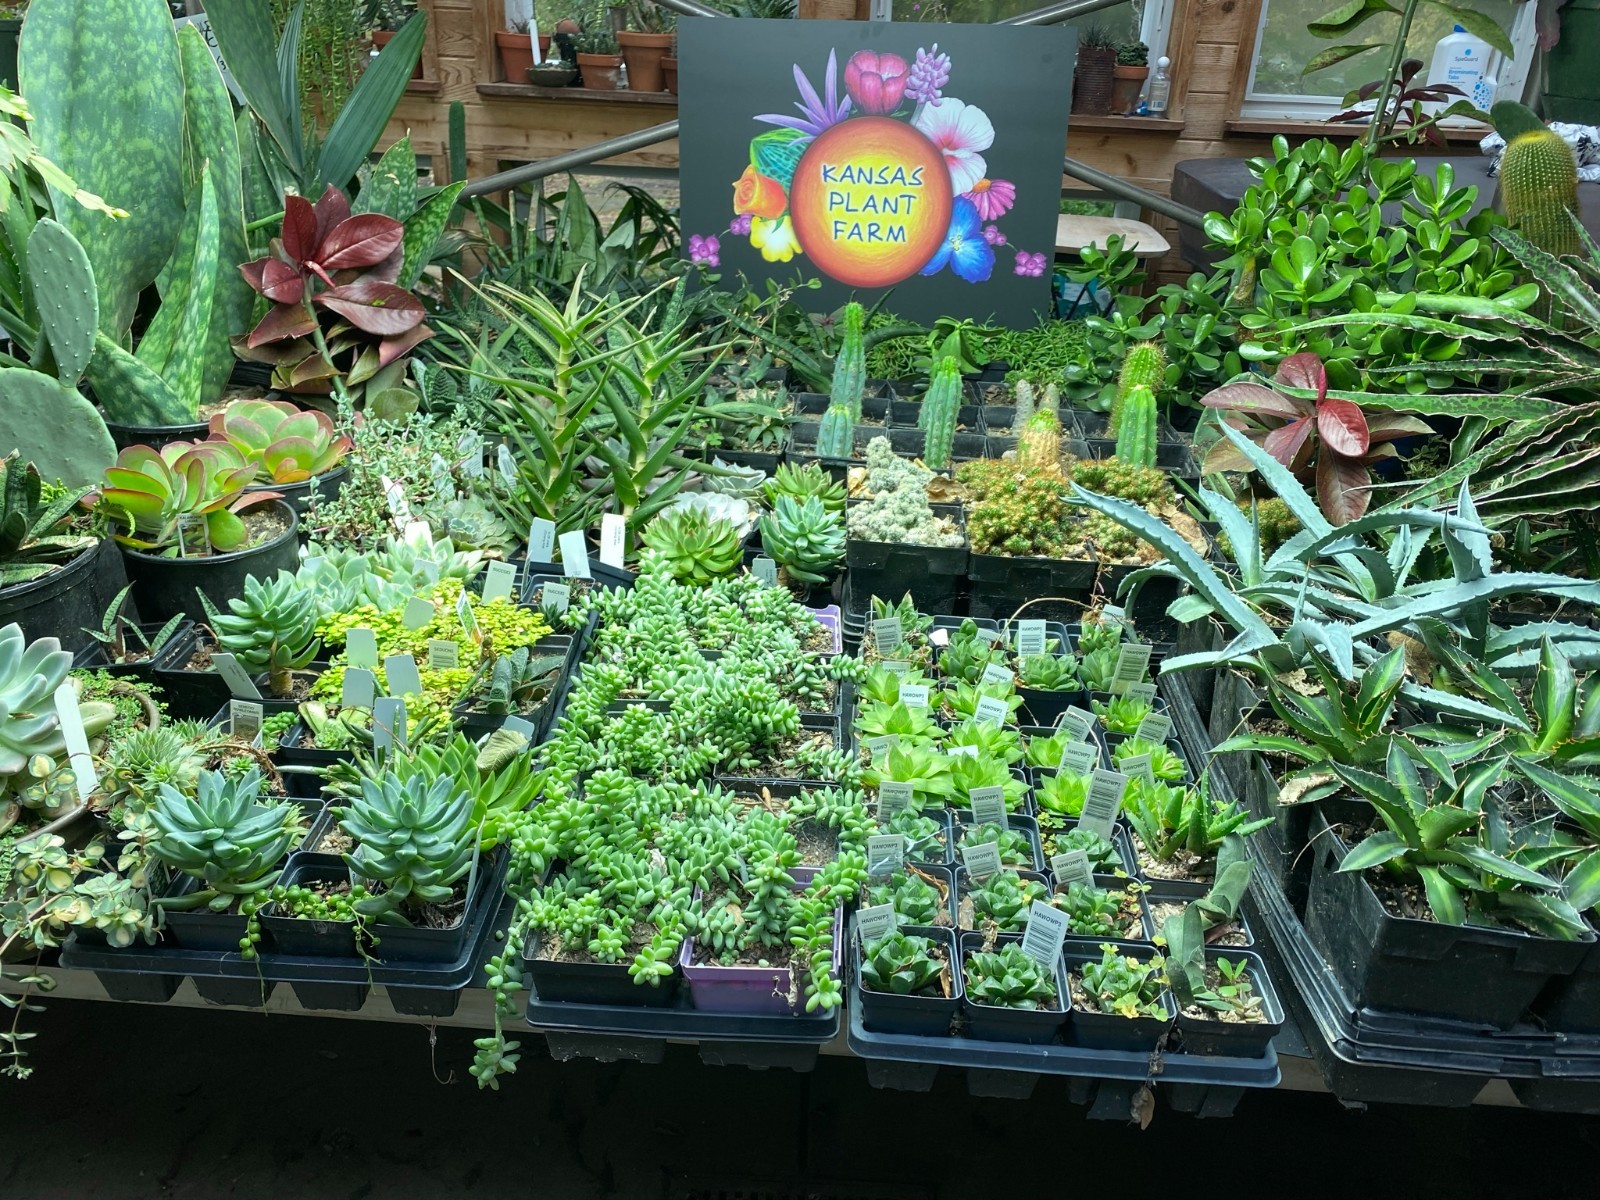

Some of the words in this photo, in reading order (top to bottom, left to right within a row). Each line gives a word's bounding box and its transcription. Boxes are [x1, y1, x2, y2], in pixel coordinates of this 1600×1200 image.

[822, 164, 924, 187] KANSAS
[829, 192, 917, 215] PLANT
[833, 221, 907, 243] FARM
